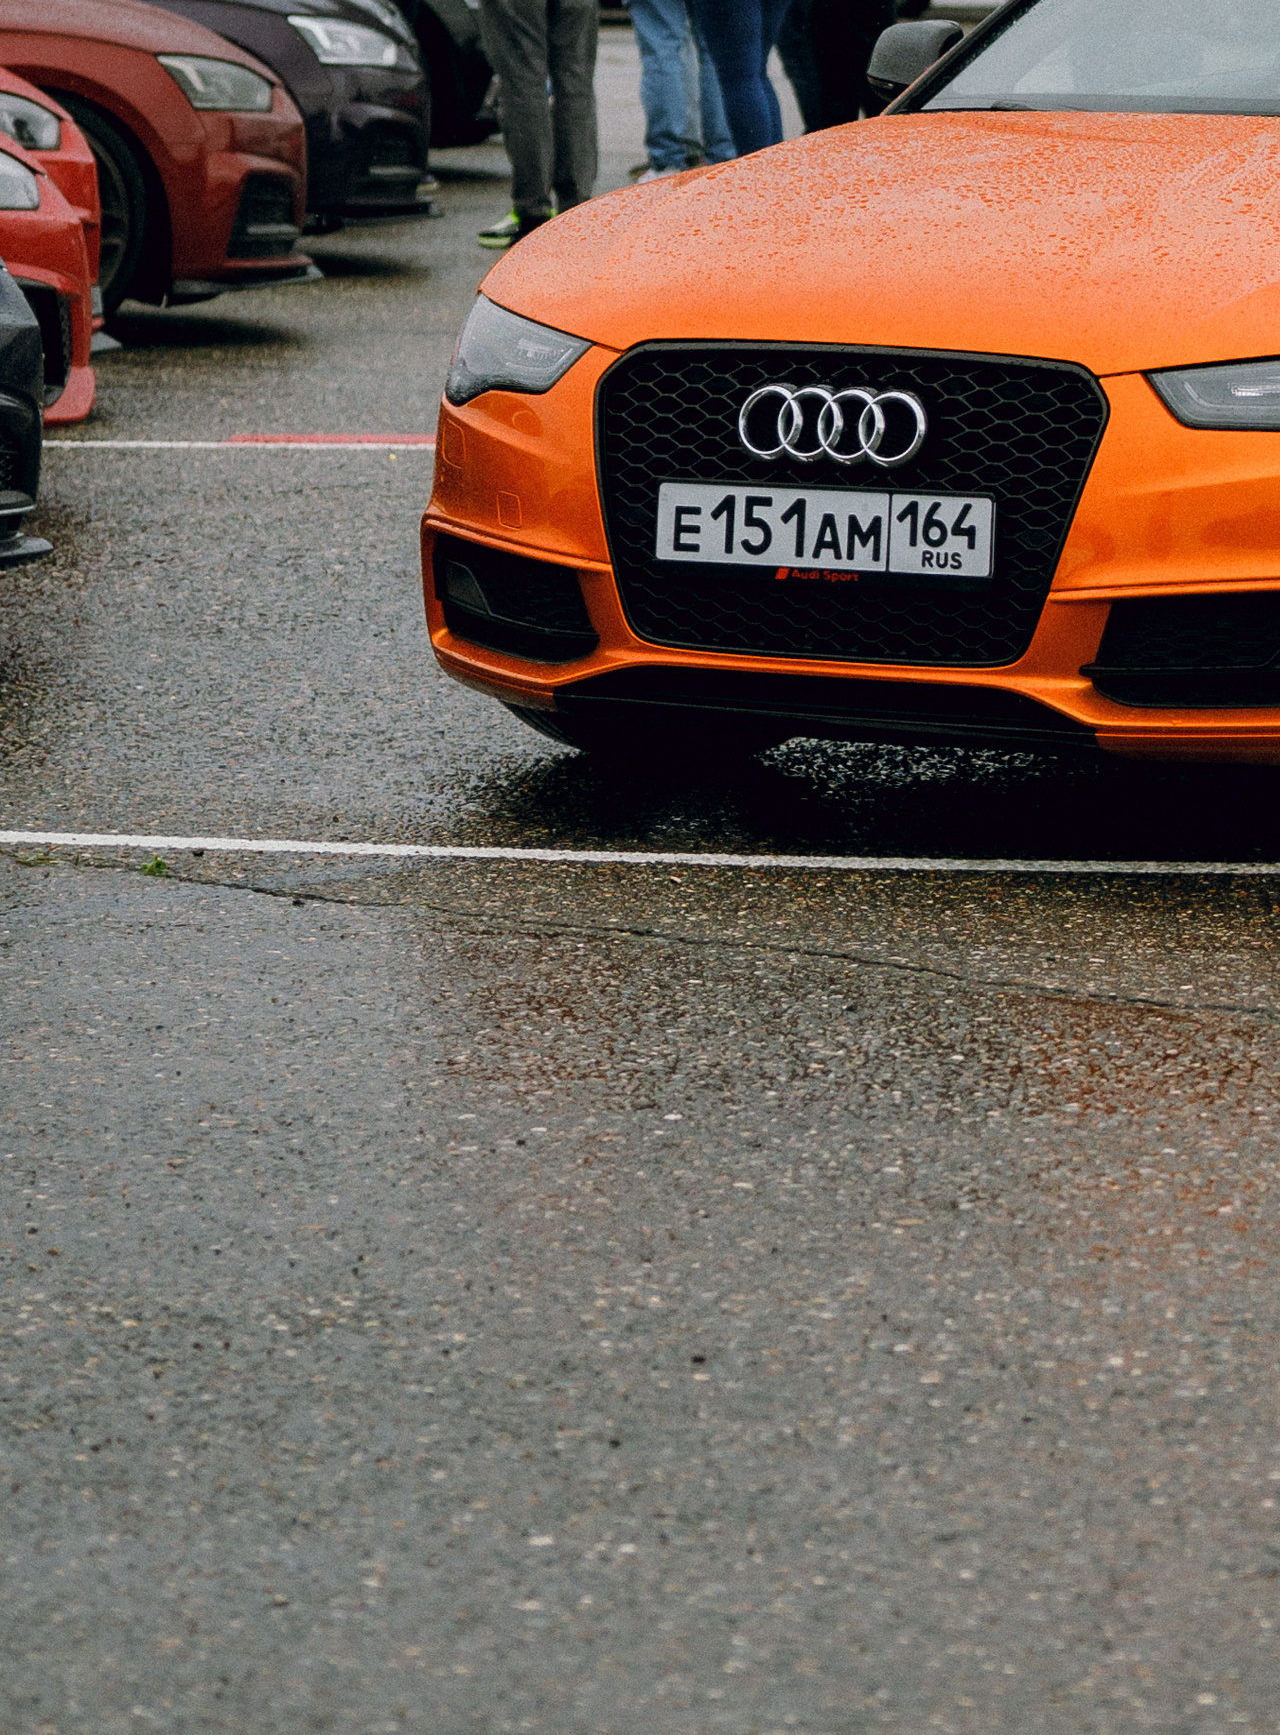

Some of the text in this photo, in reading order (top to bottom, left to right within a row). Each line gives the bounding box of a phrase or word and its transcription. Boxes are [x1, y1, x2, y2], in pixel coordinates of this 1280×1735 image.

[673, 494, 976, 562] E151AM 164
[921, 550, 963, 570] RUS
[791, 568, 859, 582] Audi Sport
